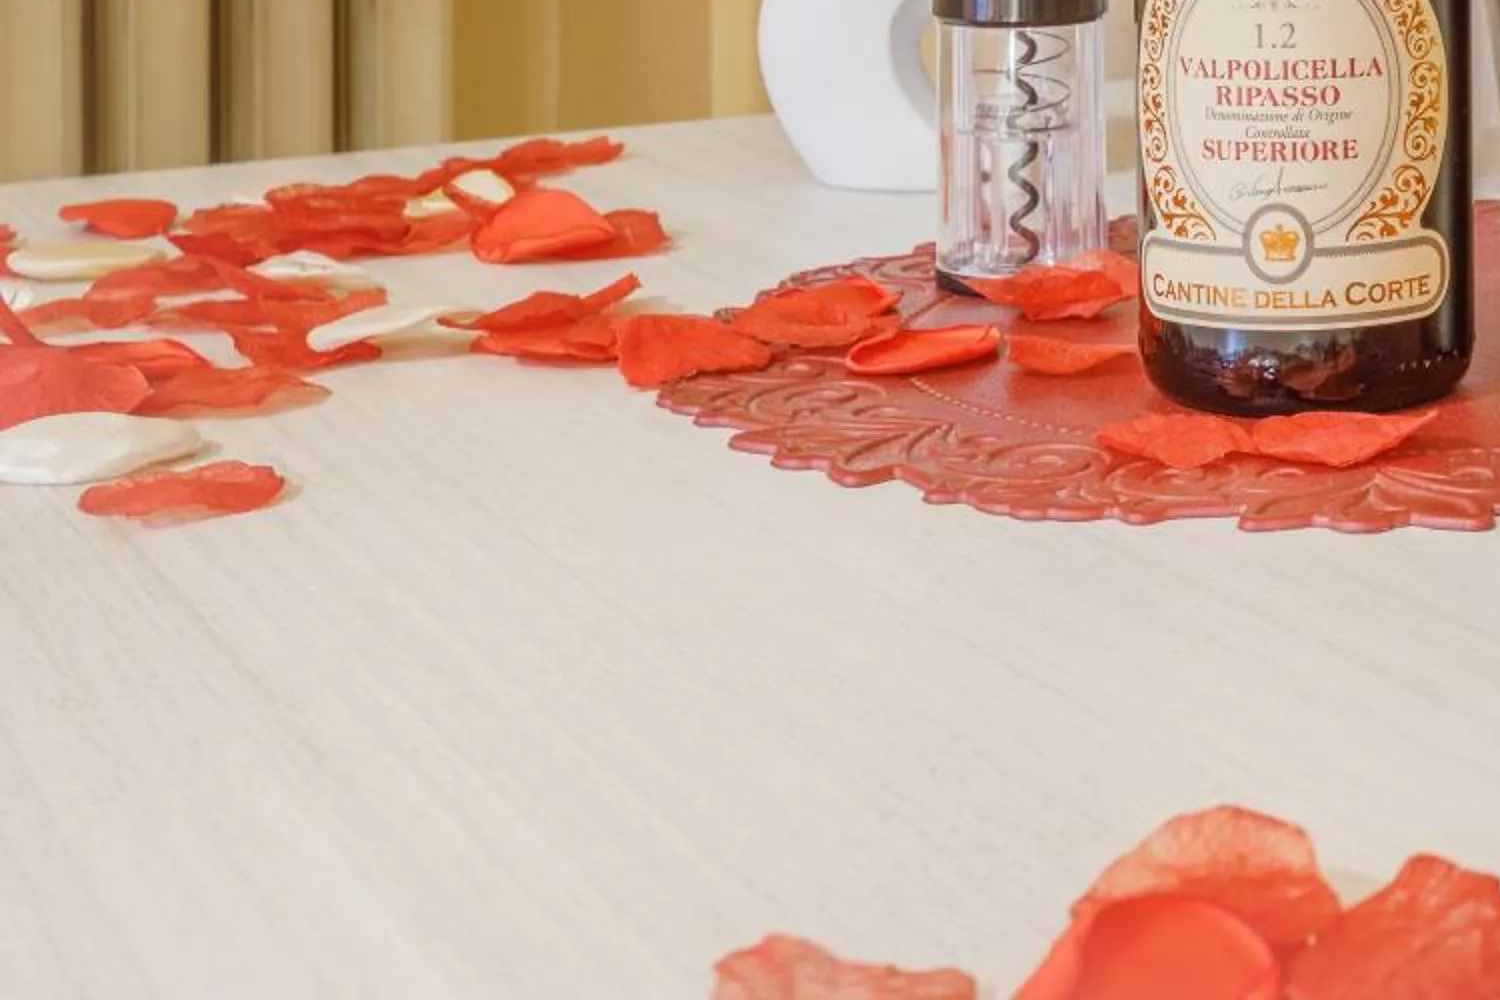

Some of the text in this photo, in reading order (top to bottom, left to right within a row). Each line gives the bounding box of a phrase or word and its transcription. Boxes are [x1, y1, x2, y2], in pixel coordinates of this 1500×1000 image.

[1254, 23, 1297, 49] 1.2
[1179, 56, 1384, 81] VALPOLICELLA
[1215, 85, 1341, 108] RIPASSO
[1204, 107, 1354, 124] Denominazione di Origine
[1201, 138, 1360, 162] SUPERIORE
[1152, 272, 1431, 310] CANTINE DELLA CORTE
